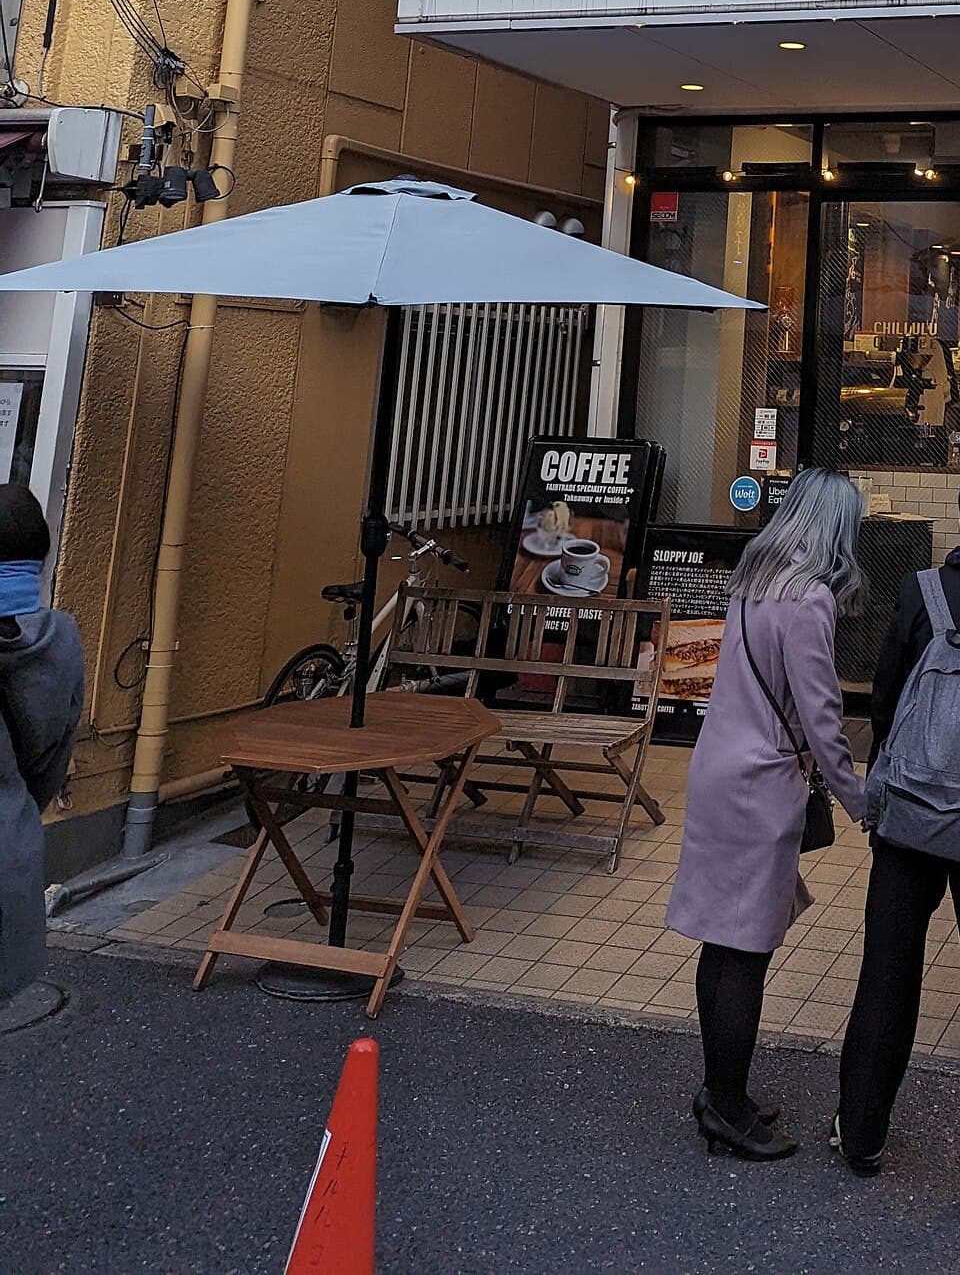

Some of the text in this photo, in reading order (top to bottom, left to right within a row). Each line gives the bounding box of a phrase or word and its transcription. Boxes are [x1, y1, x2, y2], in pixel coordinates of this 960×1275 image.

[540, 450, 632, 485] COFFEE
[545, 483, 628, 495] FAIRTRADE SPECIALTY COFFEE
[735, 489, 755, 499] Wolt
[563, 494, 594, 504] Takeaway
[595, 496, 603, 504] or
[768, 495, 784, 504] Eat
[653, 549, 705, 564] SLOPPY JOE
